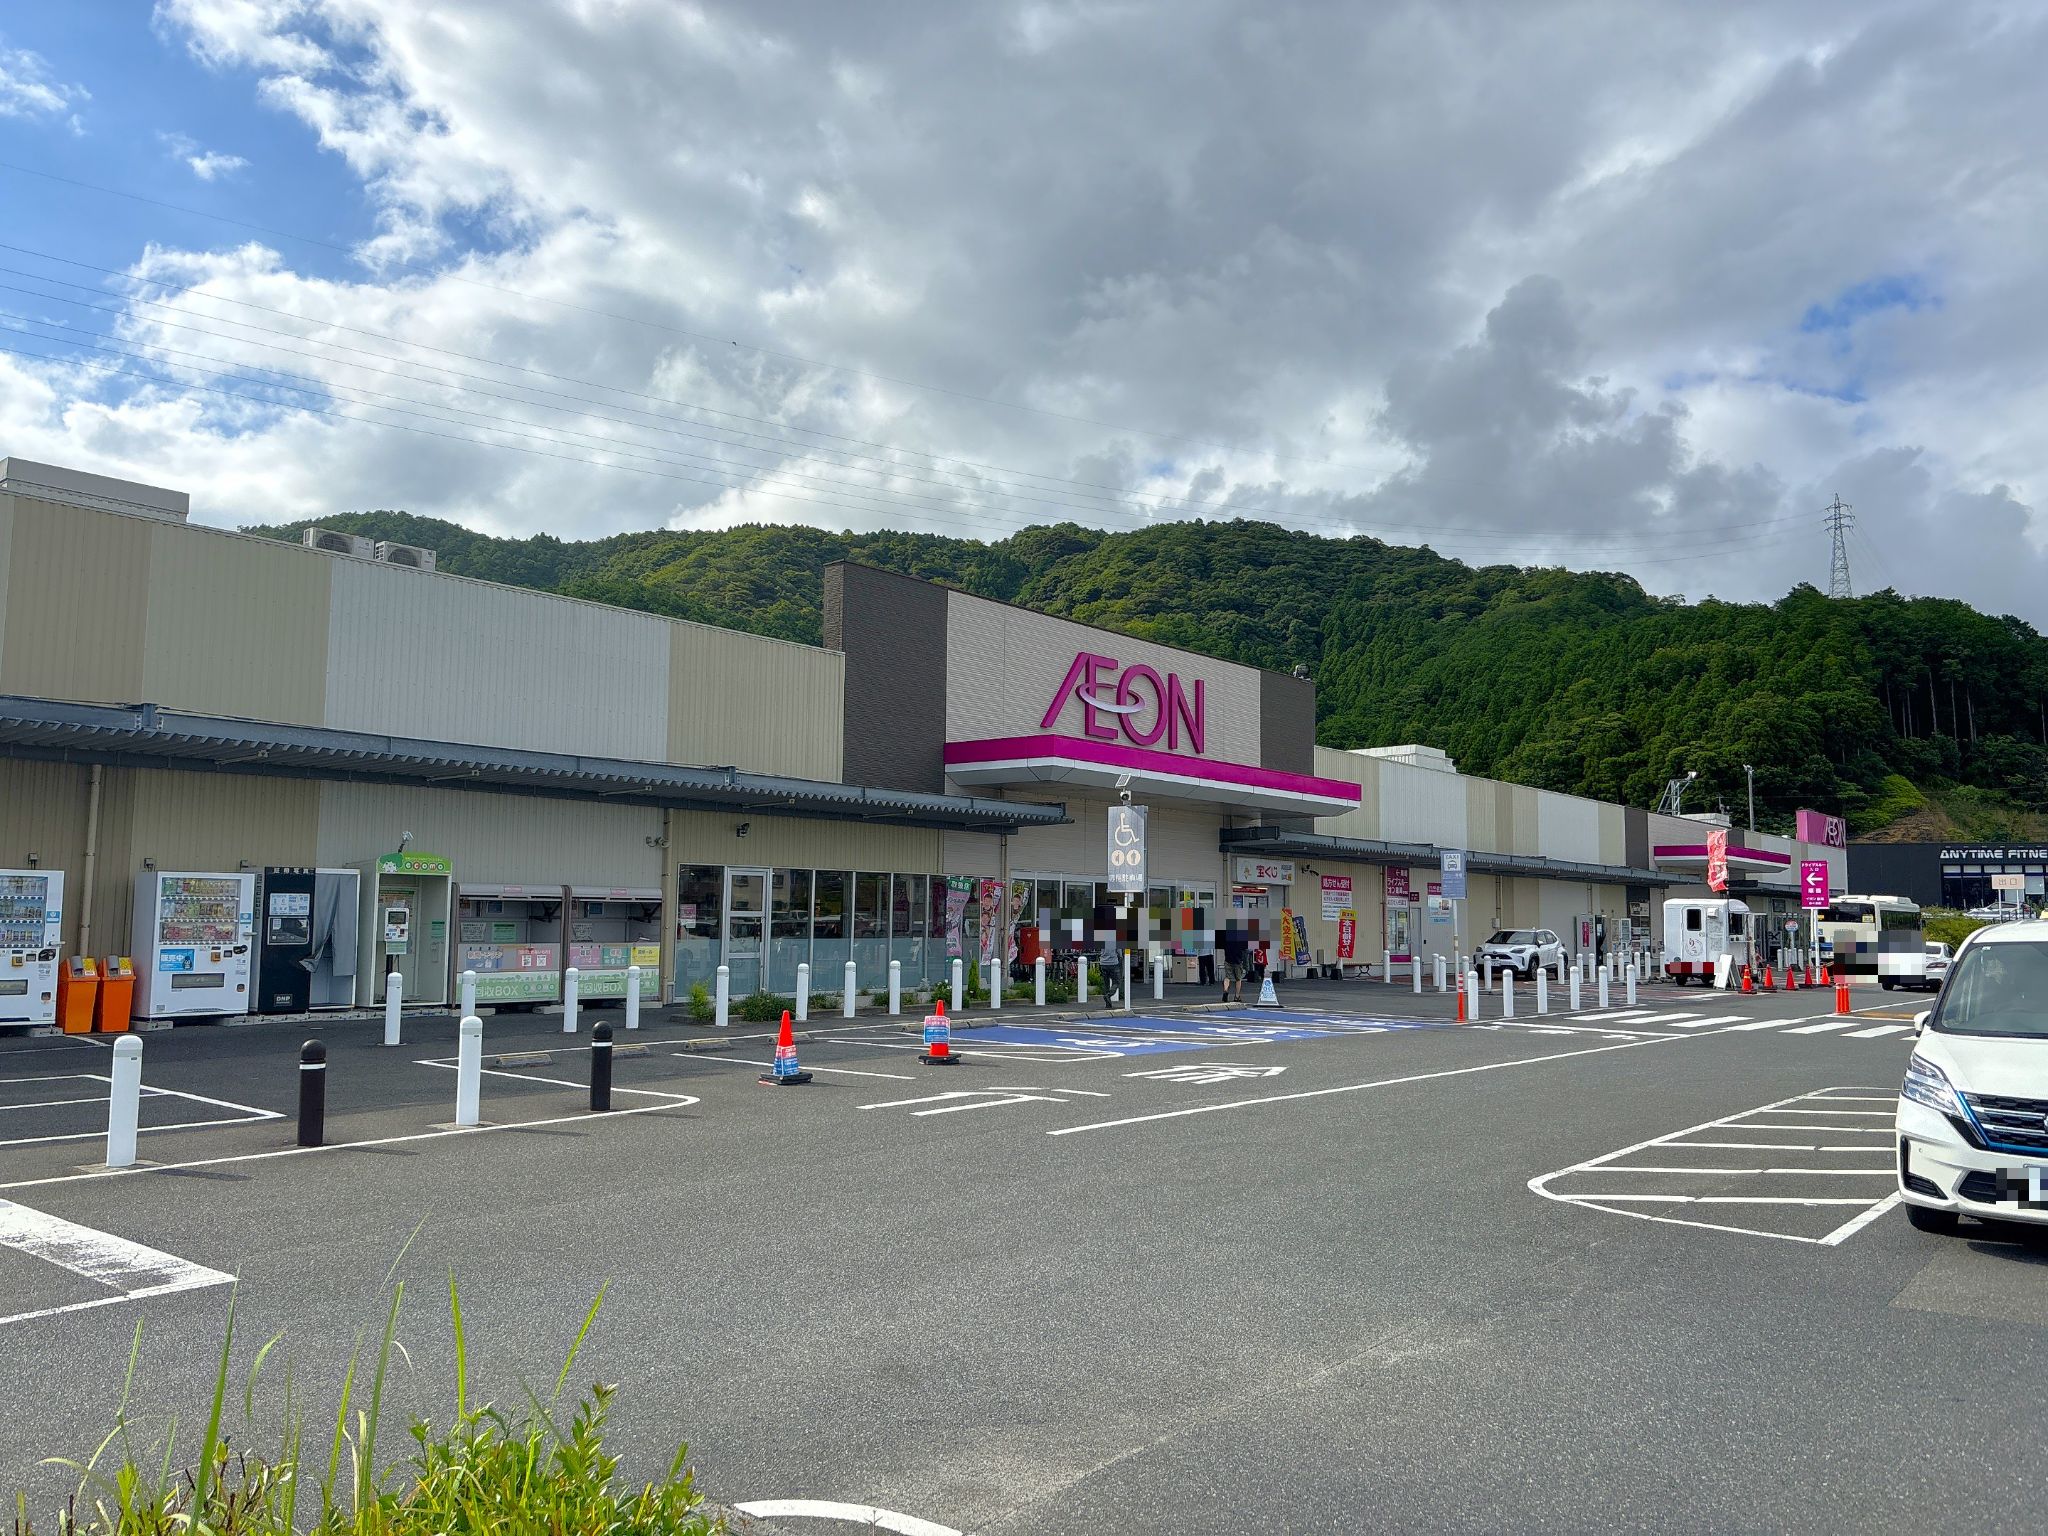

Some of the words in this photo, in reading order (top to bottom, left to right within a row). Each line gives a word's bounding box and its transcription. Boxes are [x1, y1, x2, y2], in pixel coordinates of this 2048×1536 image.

[1940, 850, 2003, 859] ANYTIME
[2008, 849, 2048, 859] FITNE
[405, 861, 444, 871] ecomo
[1256, 865, 1278, 878] 宝くじ
[1998, 878, 2017, 886] 出口
[1282, 916, 1292, 955] 大安吉日
